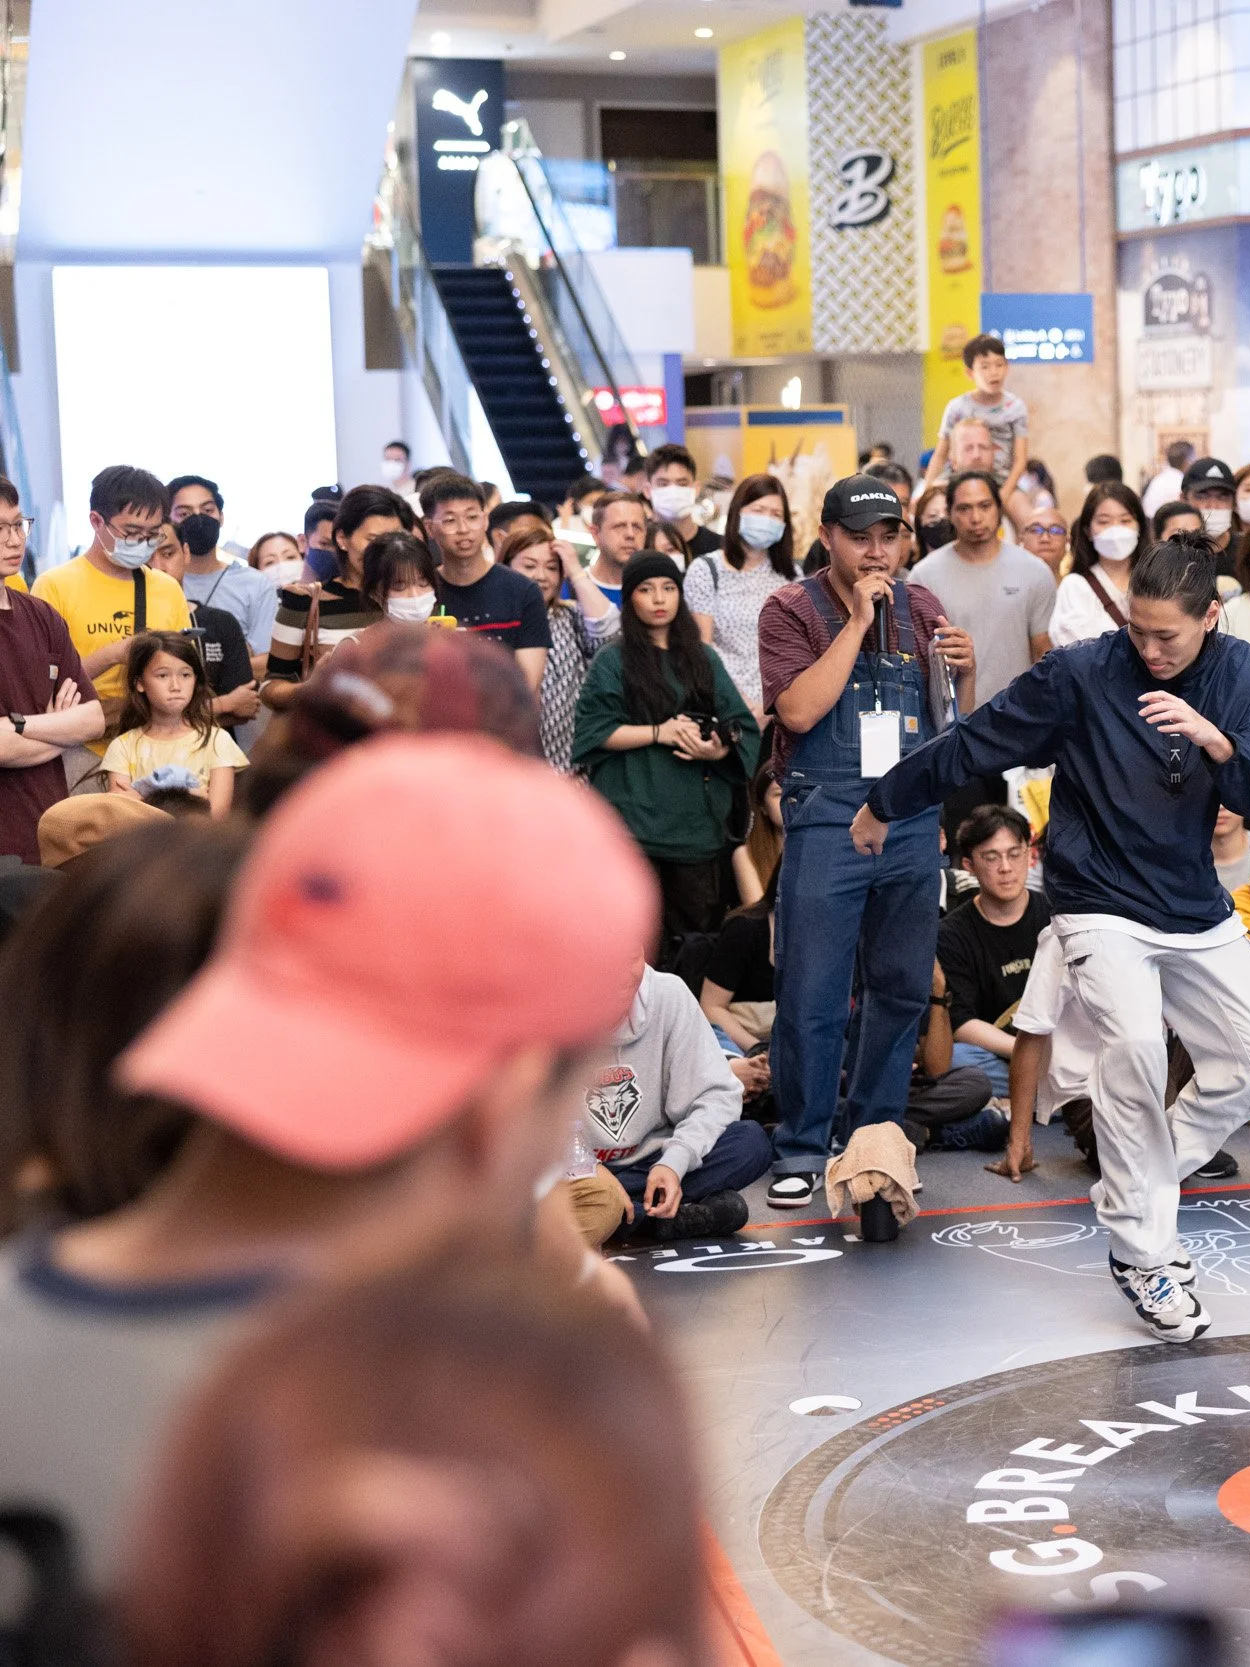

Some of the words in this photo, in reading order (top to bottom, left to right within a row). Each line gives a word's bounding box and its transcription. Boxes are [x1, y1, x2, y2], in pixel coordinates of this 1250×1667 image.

[850, 492, 897, 503] OAKLEY
[87, 622, 134, 635] UNIVE
[1169, 733, 1181, 784] IKE
